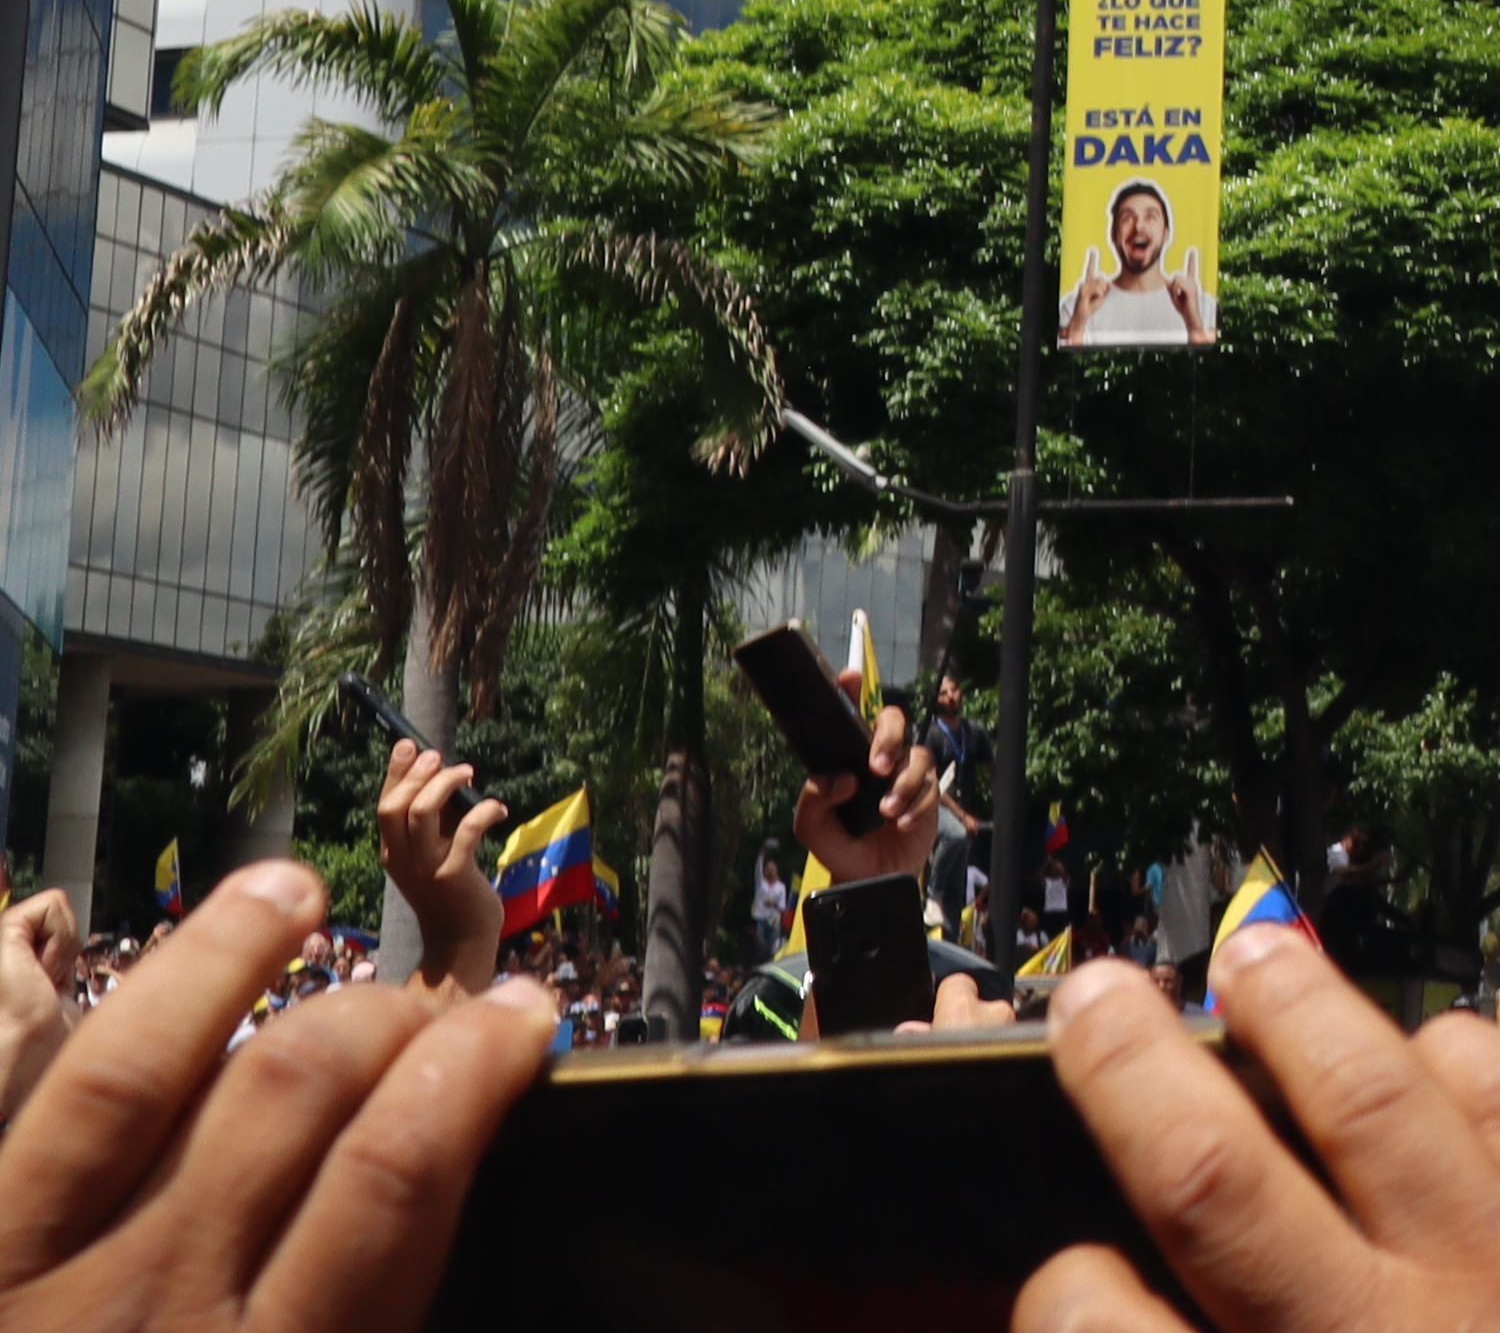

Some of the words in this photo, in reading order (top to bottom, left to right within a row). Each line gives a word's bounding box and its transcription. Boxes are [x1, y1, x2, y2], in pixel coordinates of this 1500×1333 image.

[1097, 15, 1126, 31] TE
[1134, 14, 1200, 31] HACE
[1094, 36, 1203, 58] FELIZ?
[1085, 103, 1154, 128] ESTÁ
[1164, 108, 1201, 127] EN
[1073, 134, 1211, 167] DAKA
